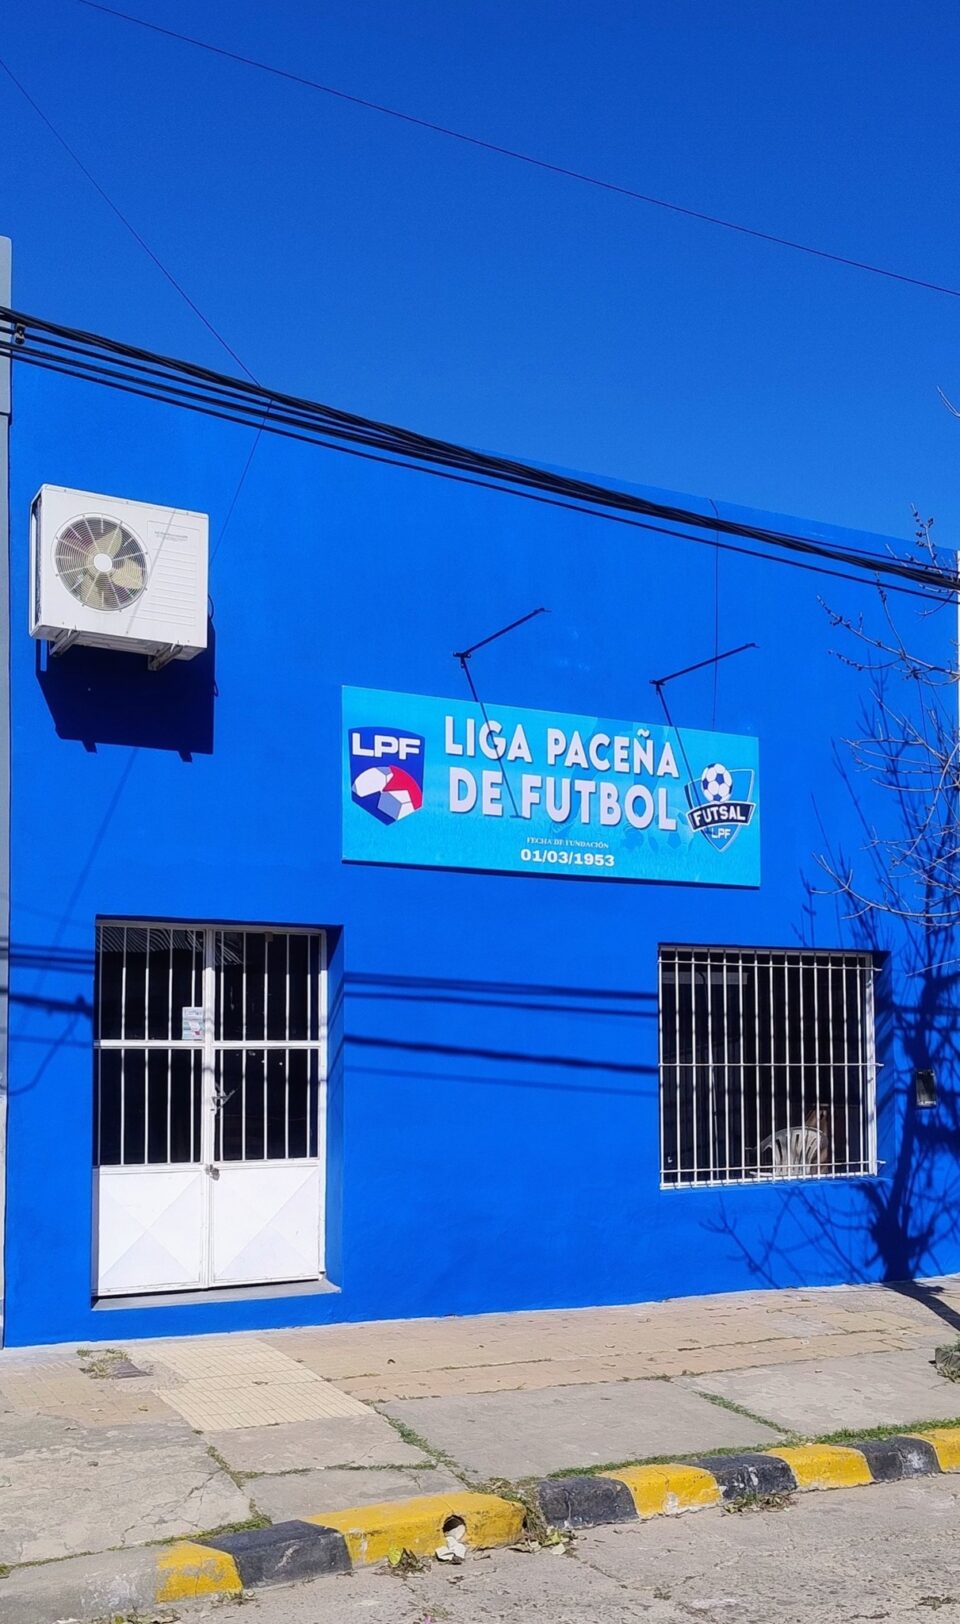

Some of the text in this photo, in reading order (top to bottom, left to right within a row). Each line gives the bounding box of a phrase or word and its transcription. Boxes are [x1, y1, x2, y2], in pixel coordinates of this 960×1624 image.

[352, 733, 421, 760] LPF
[445, 716, 680, 778] LIGA PACEÑA
[450, 767, 677, 831] DE FUTBOL
[693, 806, 746, 826] FUTSAL
[527, 837, 609, 849] FECHA DE FUNDACIÓN
[711, 827, 731, 839] LPF
[520, 848, 615, 867] 01/03/1953
